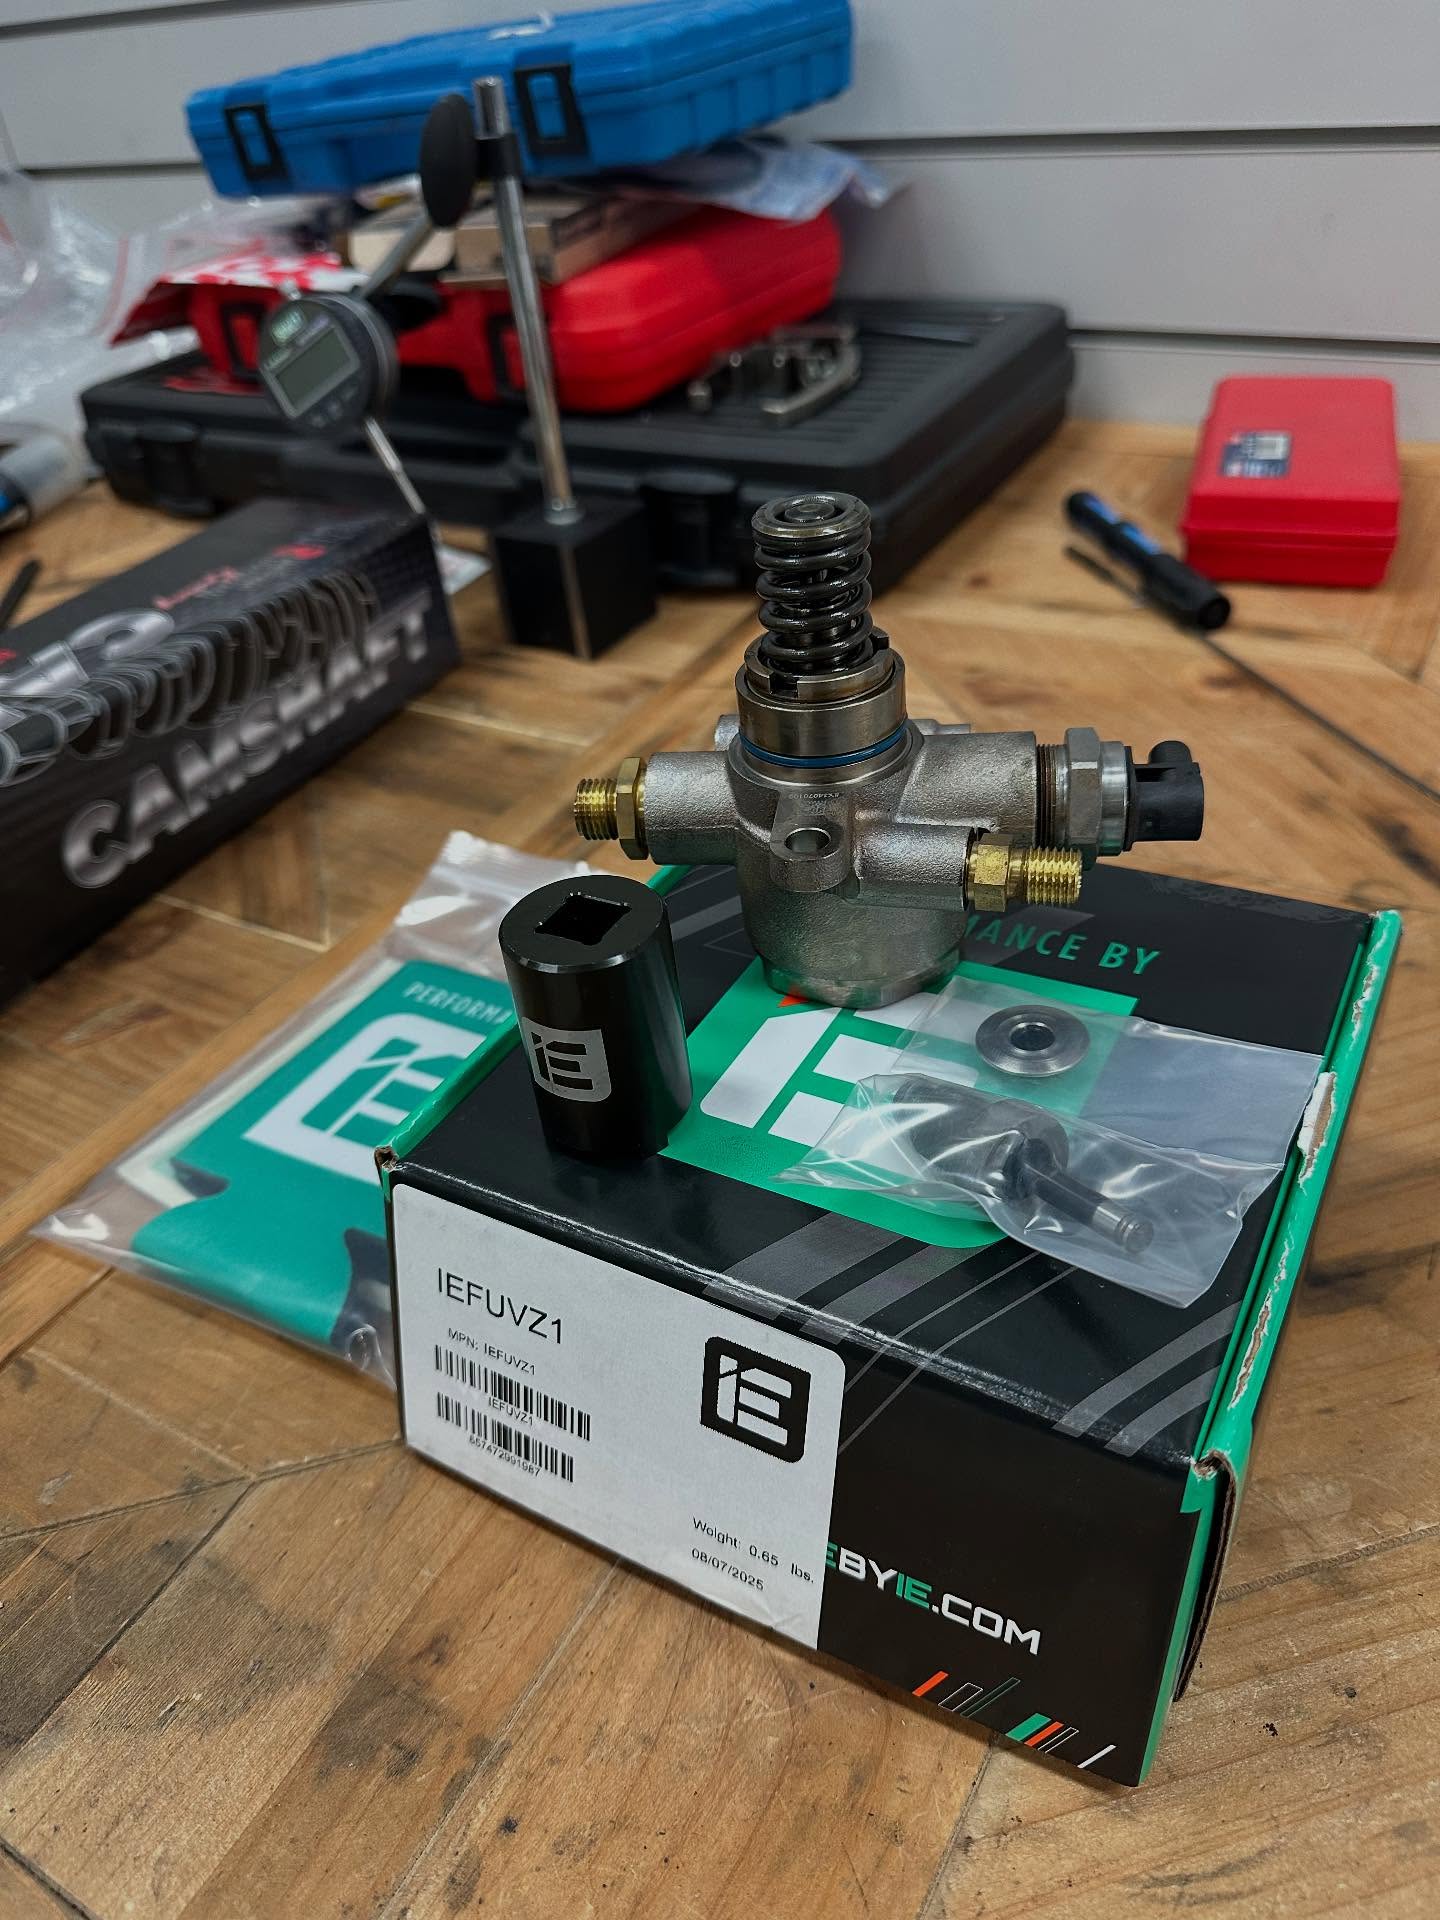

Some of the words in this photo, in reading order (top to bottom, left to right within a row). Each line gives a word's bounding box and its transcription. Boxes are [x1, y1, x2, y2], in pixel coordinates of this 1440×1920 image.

[62, 592, 432, 888] CAMSHAFT
[1098, 941, 1161, 975] BY
[438, 1267, 562, 1344] IEFUVZ1
[448, 1327, 479, 1351] MPN:
[484, 1343, 536, 1376] IEFUVZ1
[488, 1396, 534, 1426] IEFUVZ1
[690, 1547, 764, 1592] 08/07/2025
[692, 1515, 741, 1550] Weight:
[749, 1544, 779, 1567] 0.65
[790, 1562, 815, 1584] lbs.
